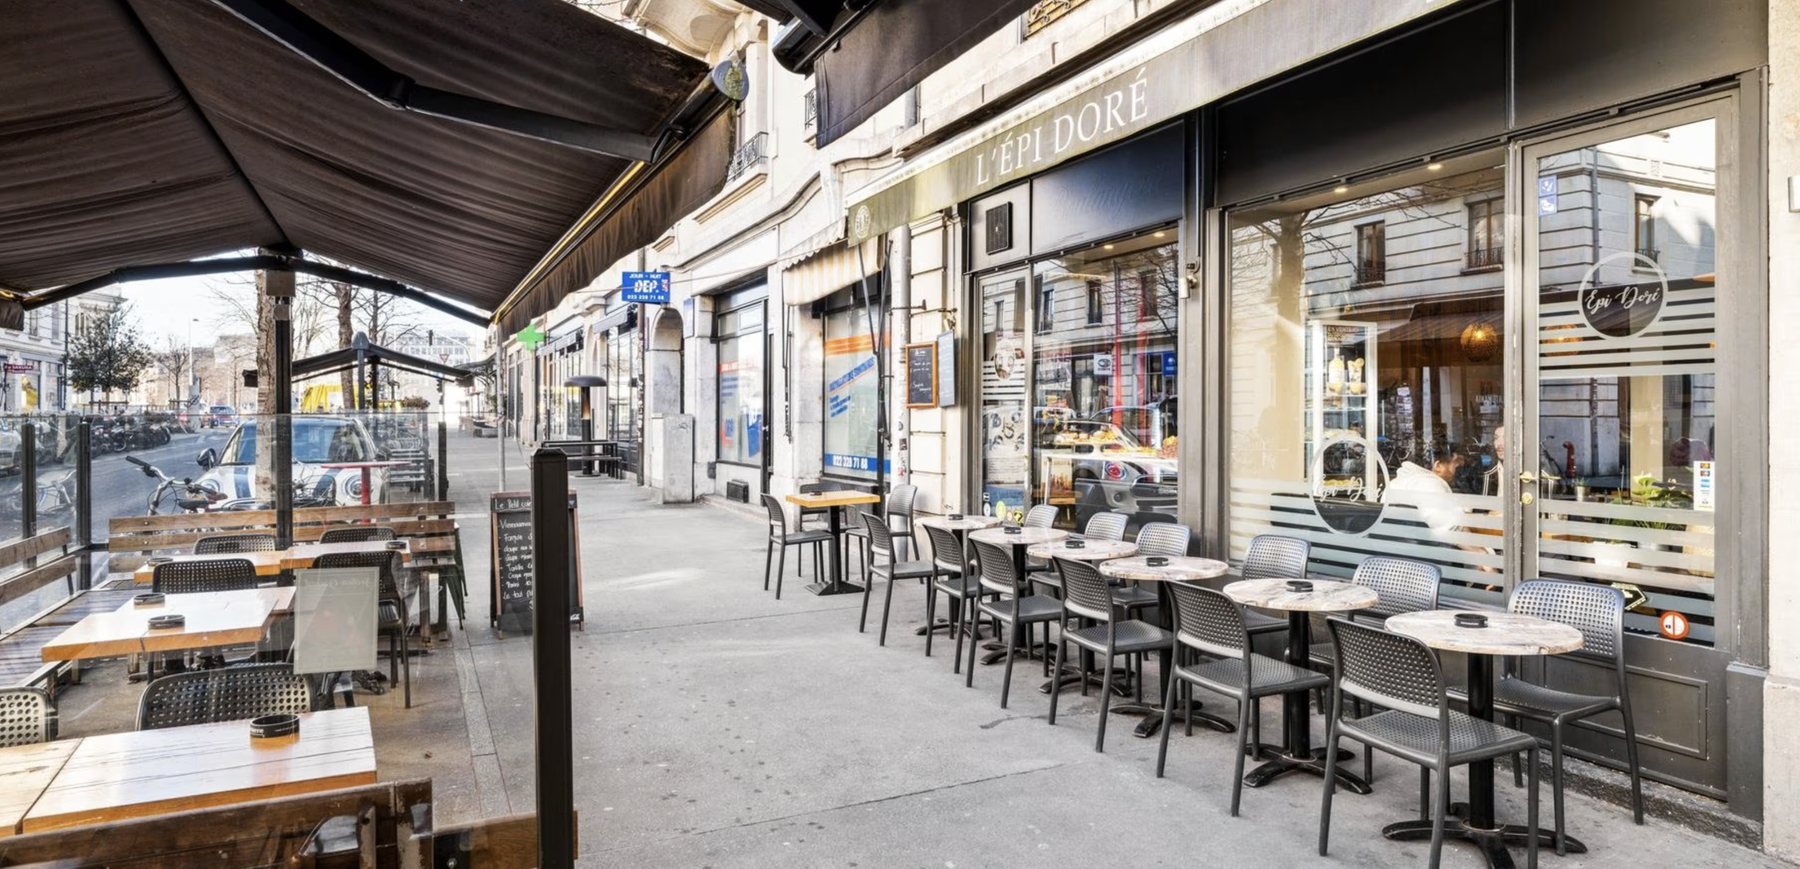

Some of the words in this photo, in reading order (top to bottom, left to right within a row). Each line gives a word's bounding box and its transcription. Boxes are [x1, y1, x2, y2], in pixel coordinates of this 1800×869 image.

[976, 126, 1043, 186] L'ÉPI
[1053, 66, 1148, 154] DORÉ
[1614, 286, 1660, 310] Doré
